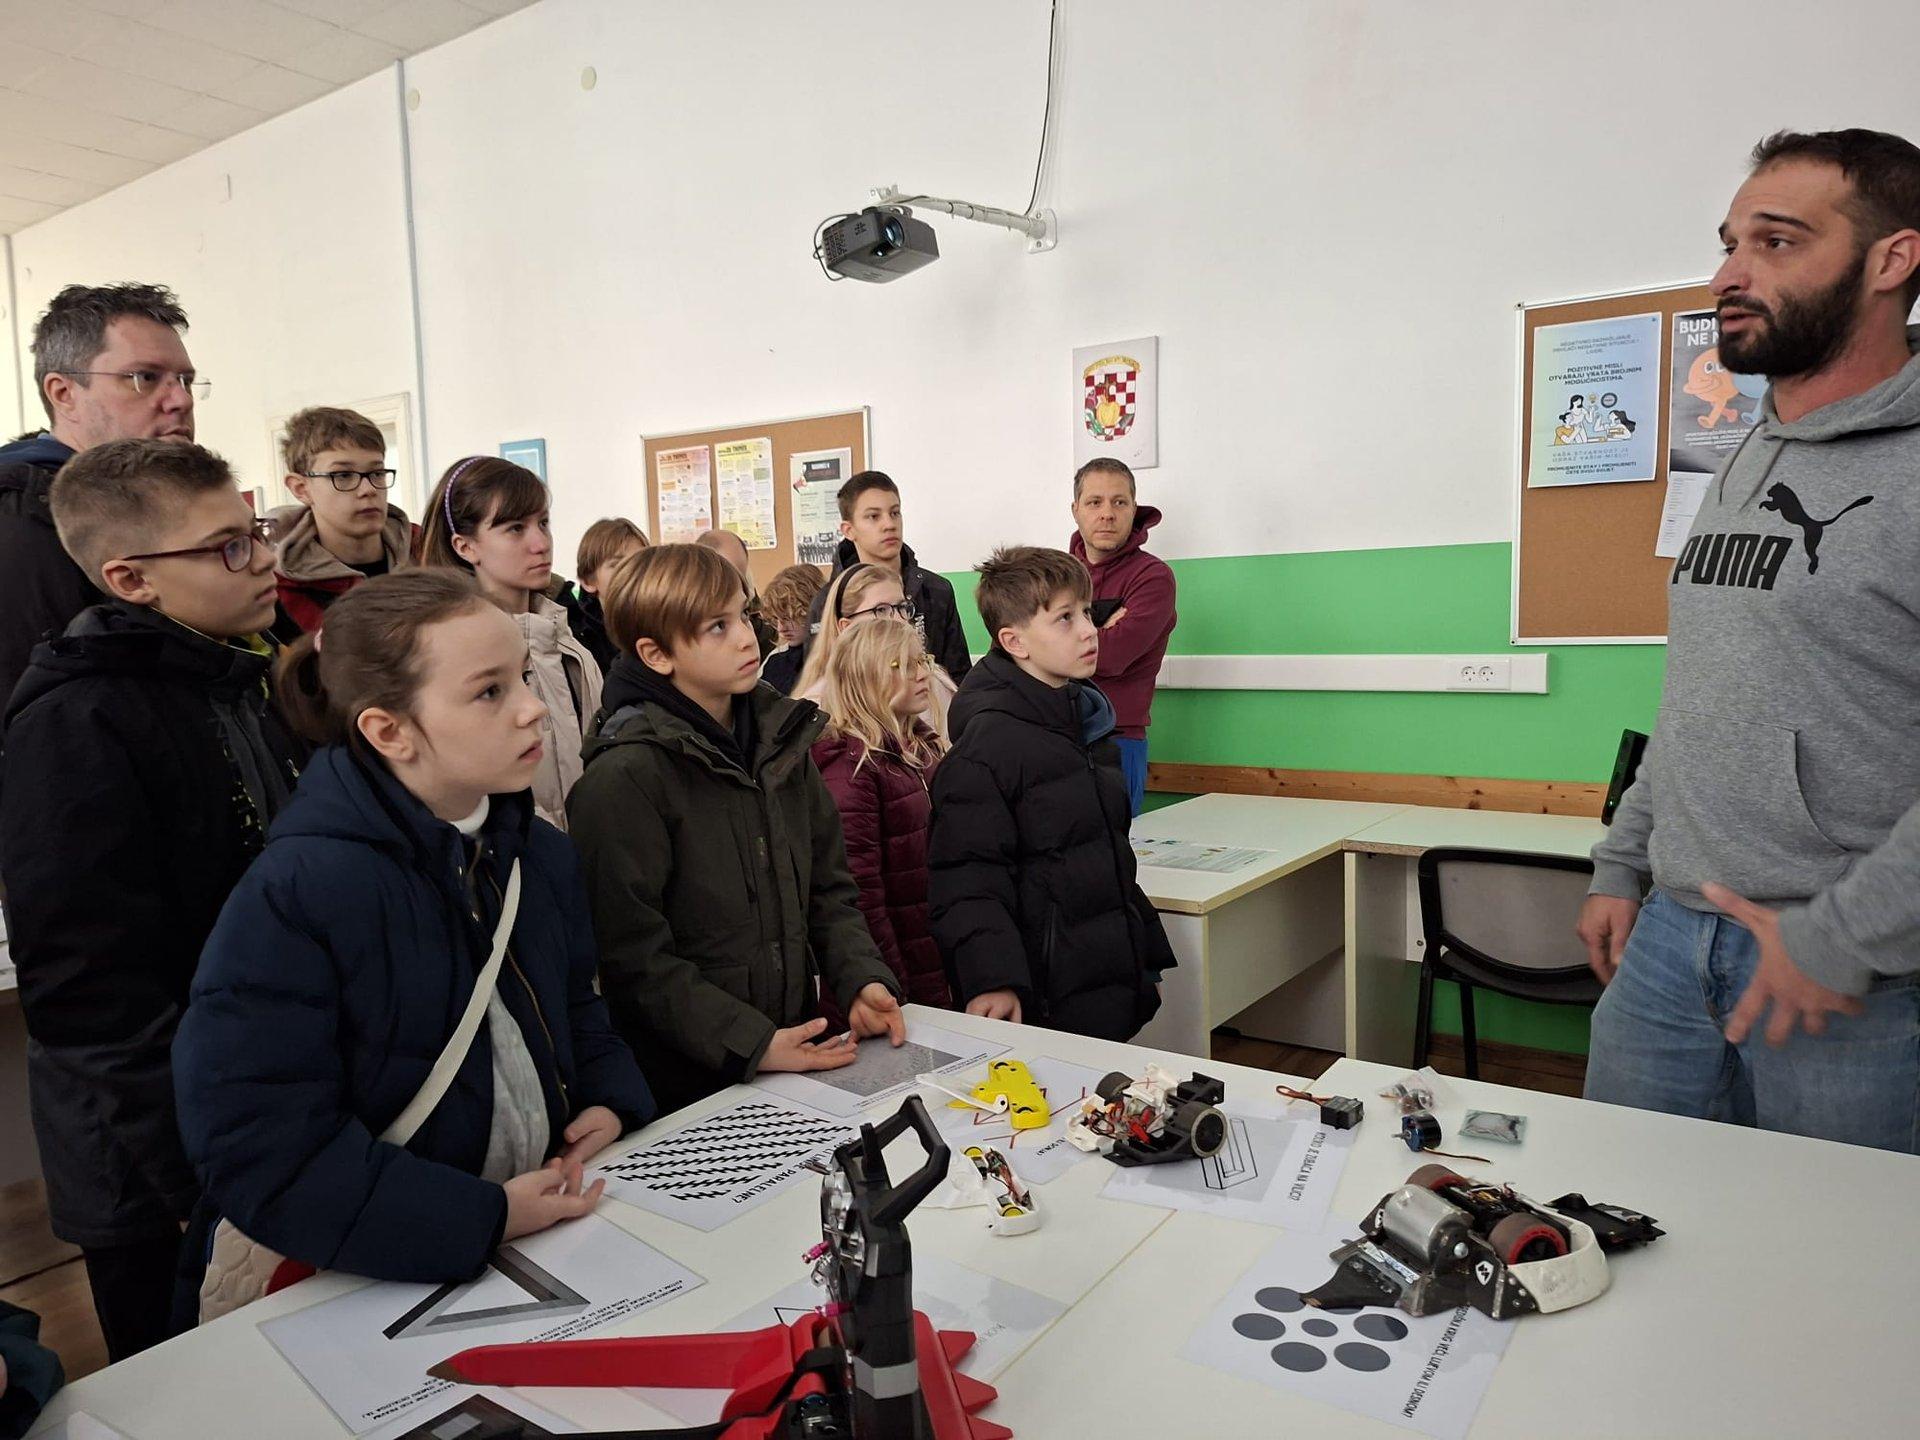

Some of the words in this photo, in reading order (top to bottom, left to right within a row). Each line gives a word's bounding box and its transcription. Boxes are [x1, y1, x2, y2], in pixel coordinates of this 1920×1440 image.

[1680, 317, 1716, 334] BUDI
[1687, 332, 1708, 346] NE
[1549, 372, 1584, 381] OTVARAJU
[1567, 365, 1603, 373] POZITIVNE
[1672, 533, 1793, 591] PUMA
[731, 1168, 791, 1205] PARALELNE?
[1441, 1327, 1457, 1343] KRUG
[1401, 1387, 1426, 1419] DESNOM?
